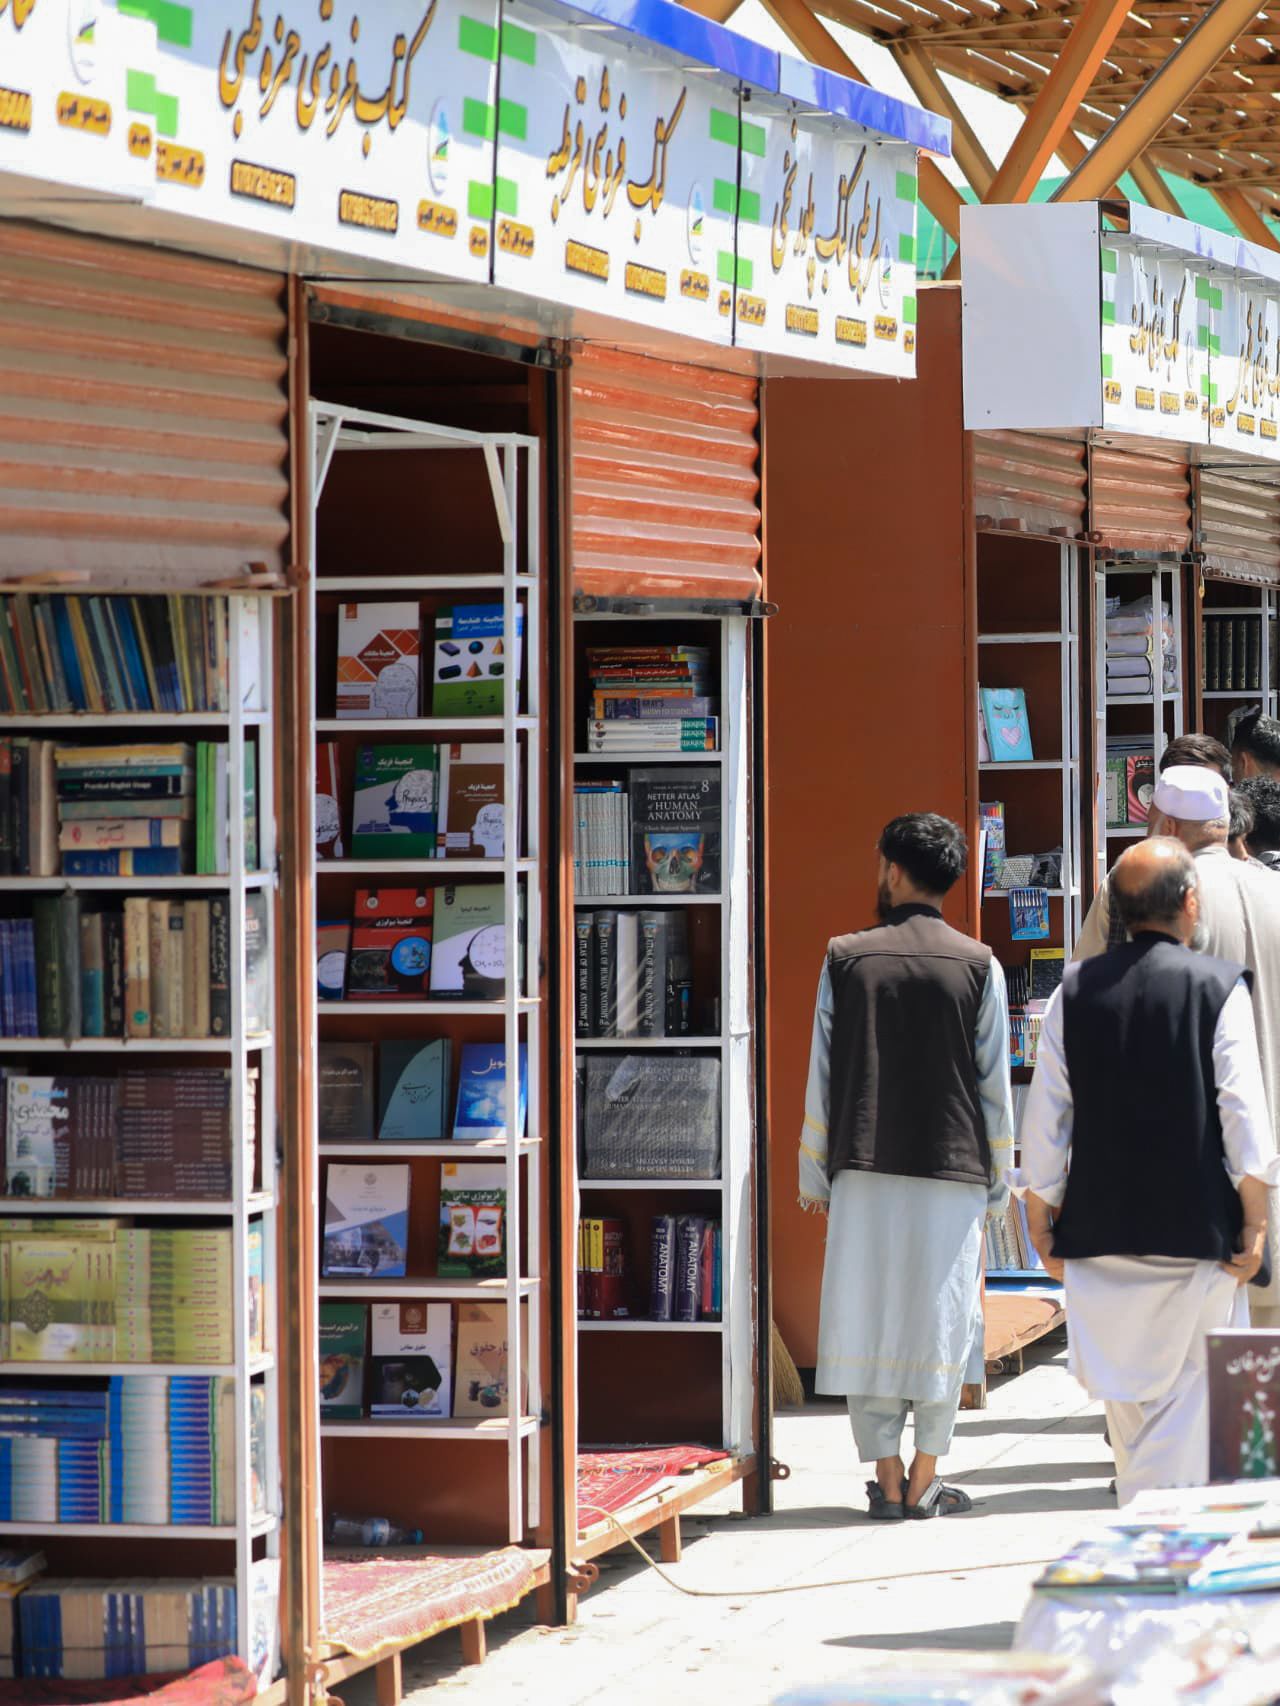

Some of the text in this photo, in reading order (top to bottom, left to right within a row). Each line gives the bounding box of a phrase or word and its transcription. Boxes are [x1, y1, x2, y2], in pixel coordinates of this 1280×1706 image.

[219, 0, 262, 139] طبی
[259, 14, 301, 118] حمزه
[296, 0, 357, 137] فروشی
[353, 0, 437, 158] کتاب
[583, 65, 626, 218] فروشی
[626, 86, 688, 243] کتاب
[815, 144, 867, 294] کتاب
[110, 782, 131, 790] English
[132, 781, 151, 790] Usage
[647, 792, 701, 801] NETTER ATLAS
[647, 810, 702, 821] ANATOMY
[655, 801, 698, 811] HUMAN
[701, 779, 710, 793] 8
[657, 1243, 668, 1295] ANATOMY
[686, 1241, 699, 1293] ANATOMY
